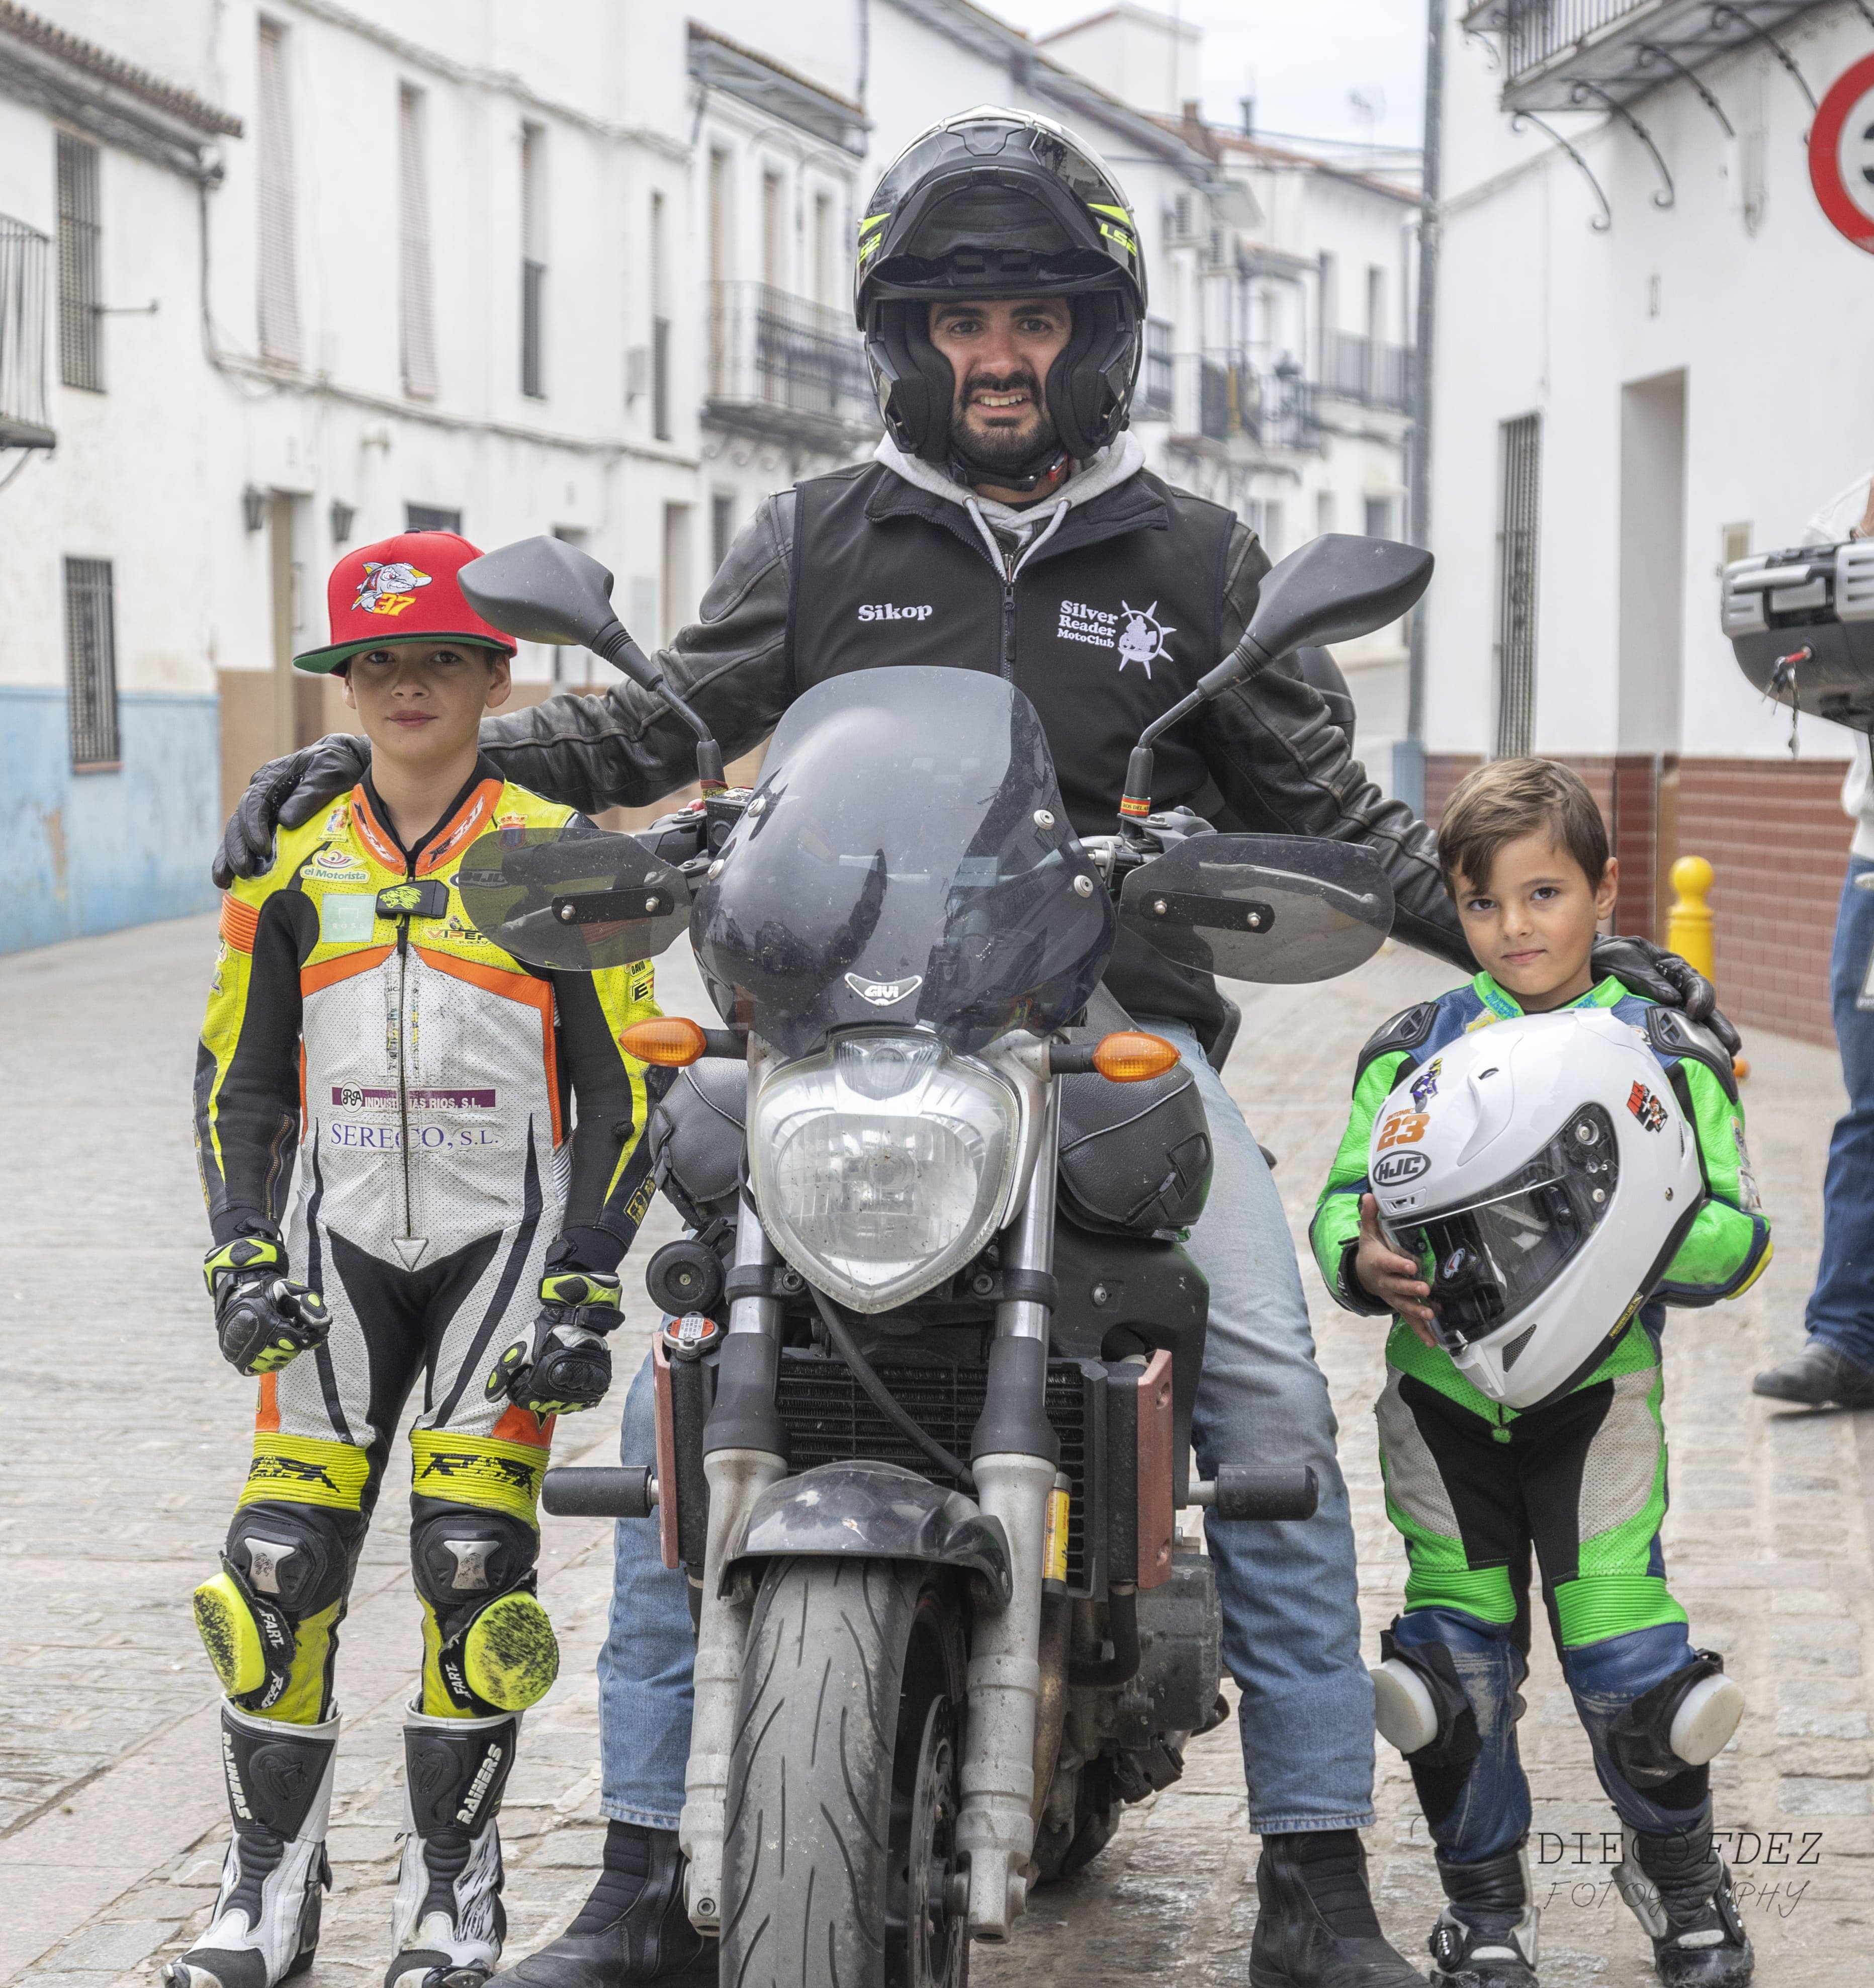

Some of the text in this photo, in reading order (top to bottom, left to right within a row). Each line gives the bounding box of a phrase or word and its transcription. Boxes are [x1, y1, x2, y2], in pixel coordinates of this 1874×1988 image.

[1100, 223, 1137, 257] LS2
[374, 592, 416, 616] 37
[858, 603, 933, 621] Sikop
[1060, 600, 1119, 625] Silver
[1058, 614, 1116, 637] Reader
[1057, 628, 1115, 648] MotoClub
[316, 870, 366, 880] Motorista
[864, 985, 899, 998] GIVI
[365, 1096, 426, 1109] INDUSTIAS
[461, 1130, 498, 1146] S.L.
[1376, 1113, 1431, 1153] 23
[1378, 1156, 1422, 1181] HJC
[261, 1613, 285, 1646] FART
[445, 1664, 469, 1694] FART
[456, 1743, 502, 1825] RAINERS
